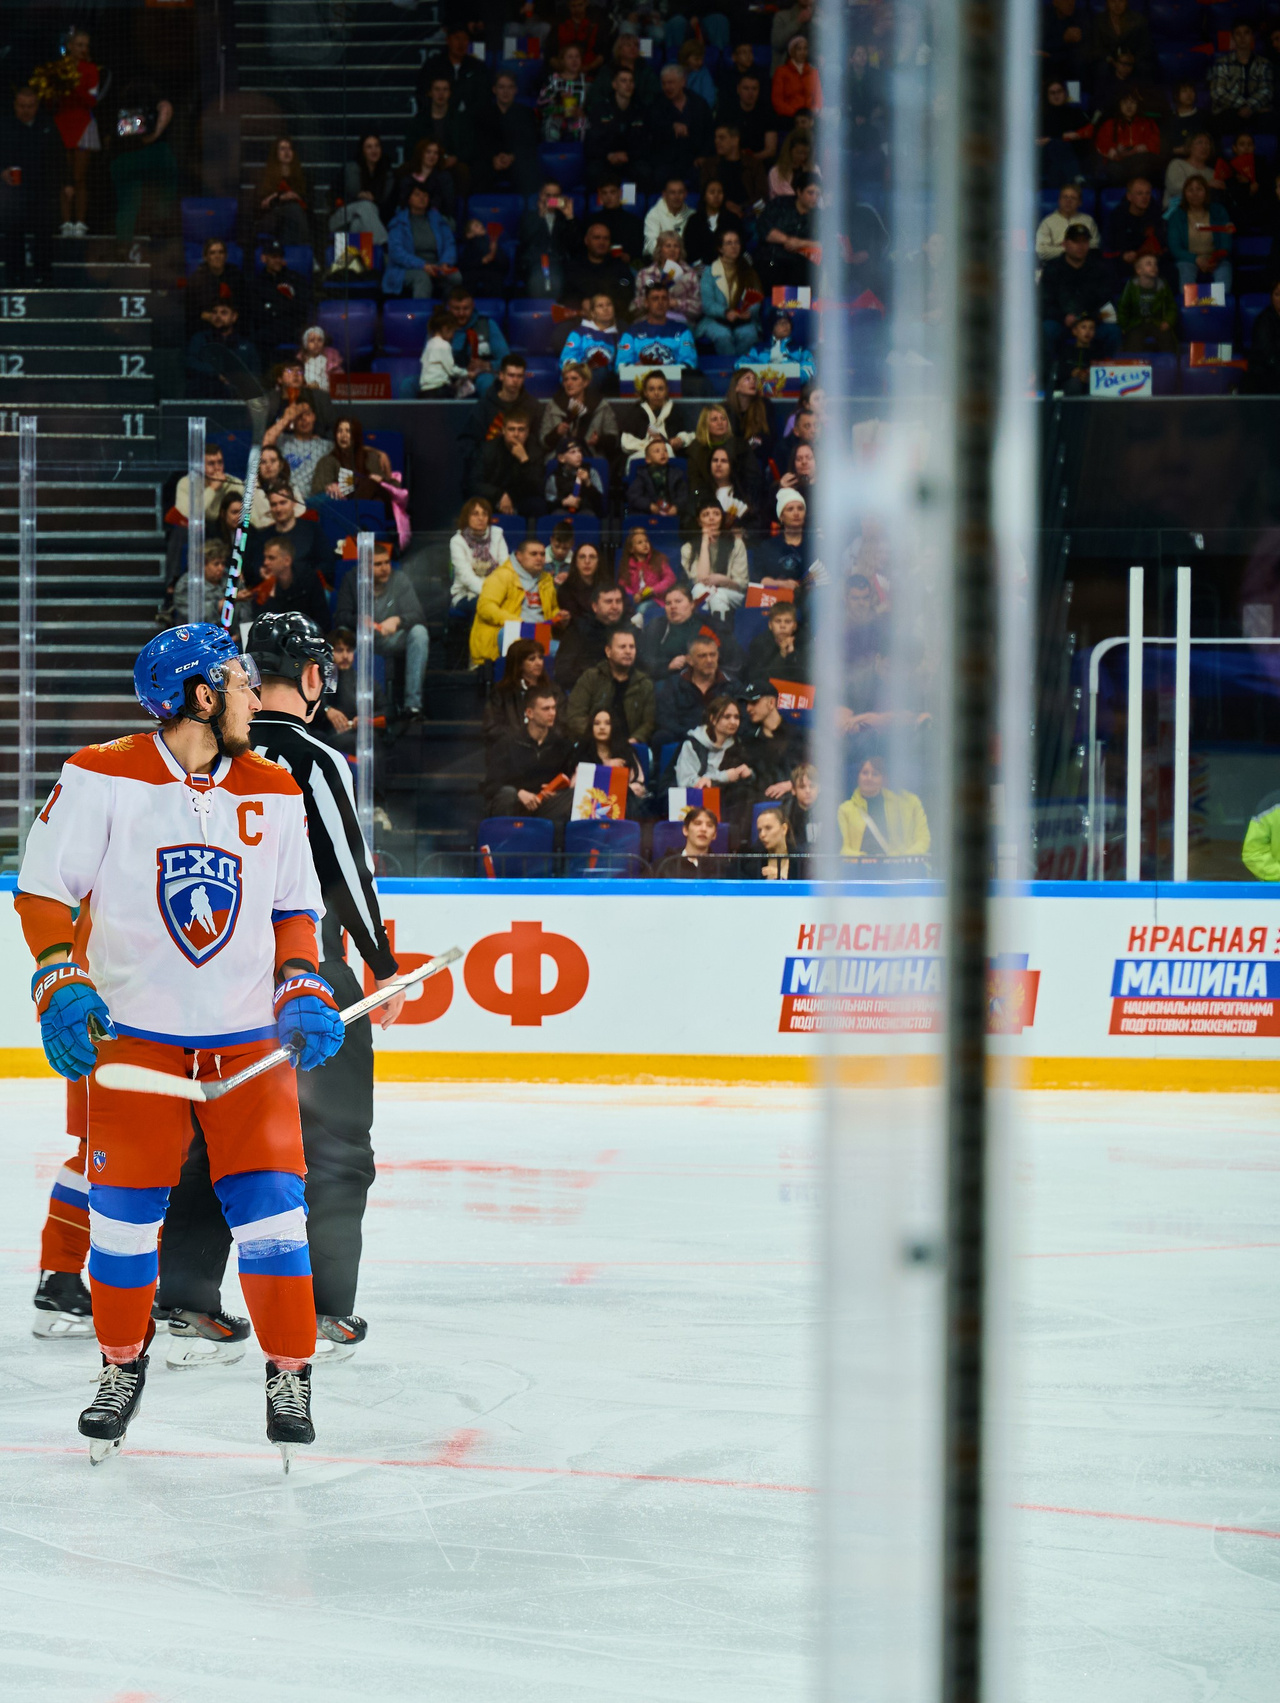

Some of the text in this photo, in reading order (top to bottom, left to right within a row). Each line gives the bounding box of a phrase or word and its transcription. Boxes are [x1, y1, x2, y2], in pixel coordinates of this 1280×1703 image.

[0, 296, 27, 318] 13
[120, 296, 147, 318] 13
[120, 354, 146, 377] 12
[122, 413, 145, 437] 11
[175, 660, 200, 674] CCM
[236, 801, 264, 846] C
[797, 923, 942, 951] КРАСНАЯ
[1127, 925, 1268, 953] КРАСНАЯ
[790, 958, 941, 994] МАШИНА
[1120, 961, 1268, 997] МАШИНА
[1123, 1000, 1274, 1017] НАЦИОНАЛЬНАЯ ПРОГРАММА
[1120, 1018, 1257, 1034] ПОДГОТОВКИ ХОККЕИСТОВ
